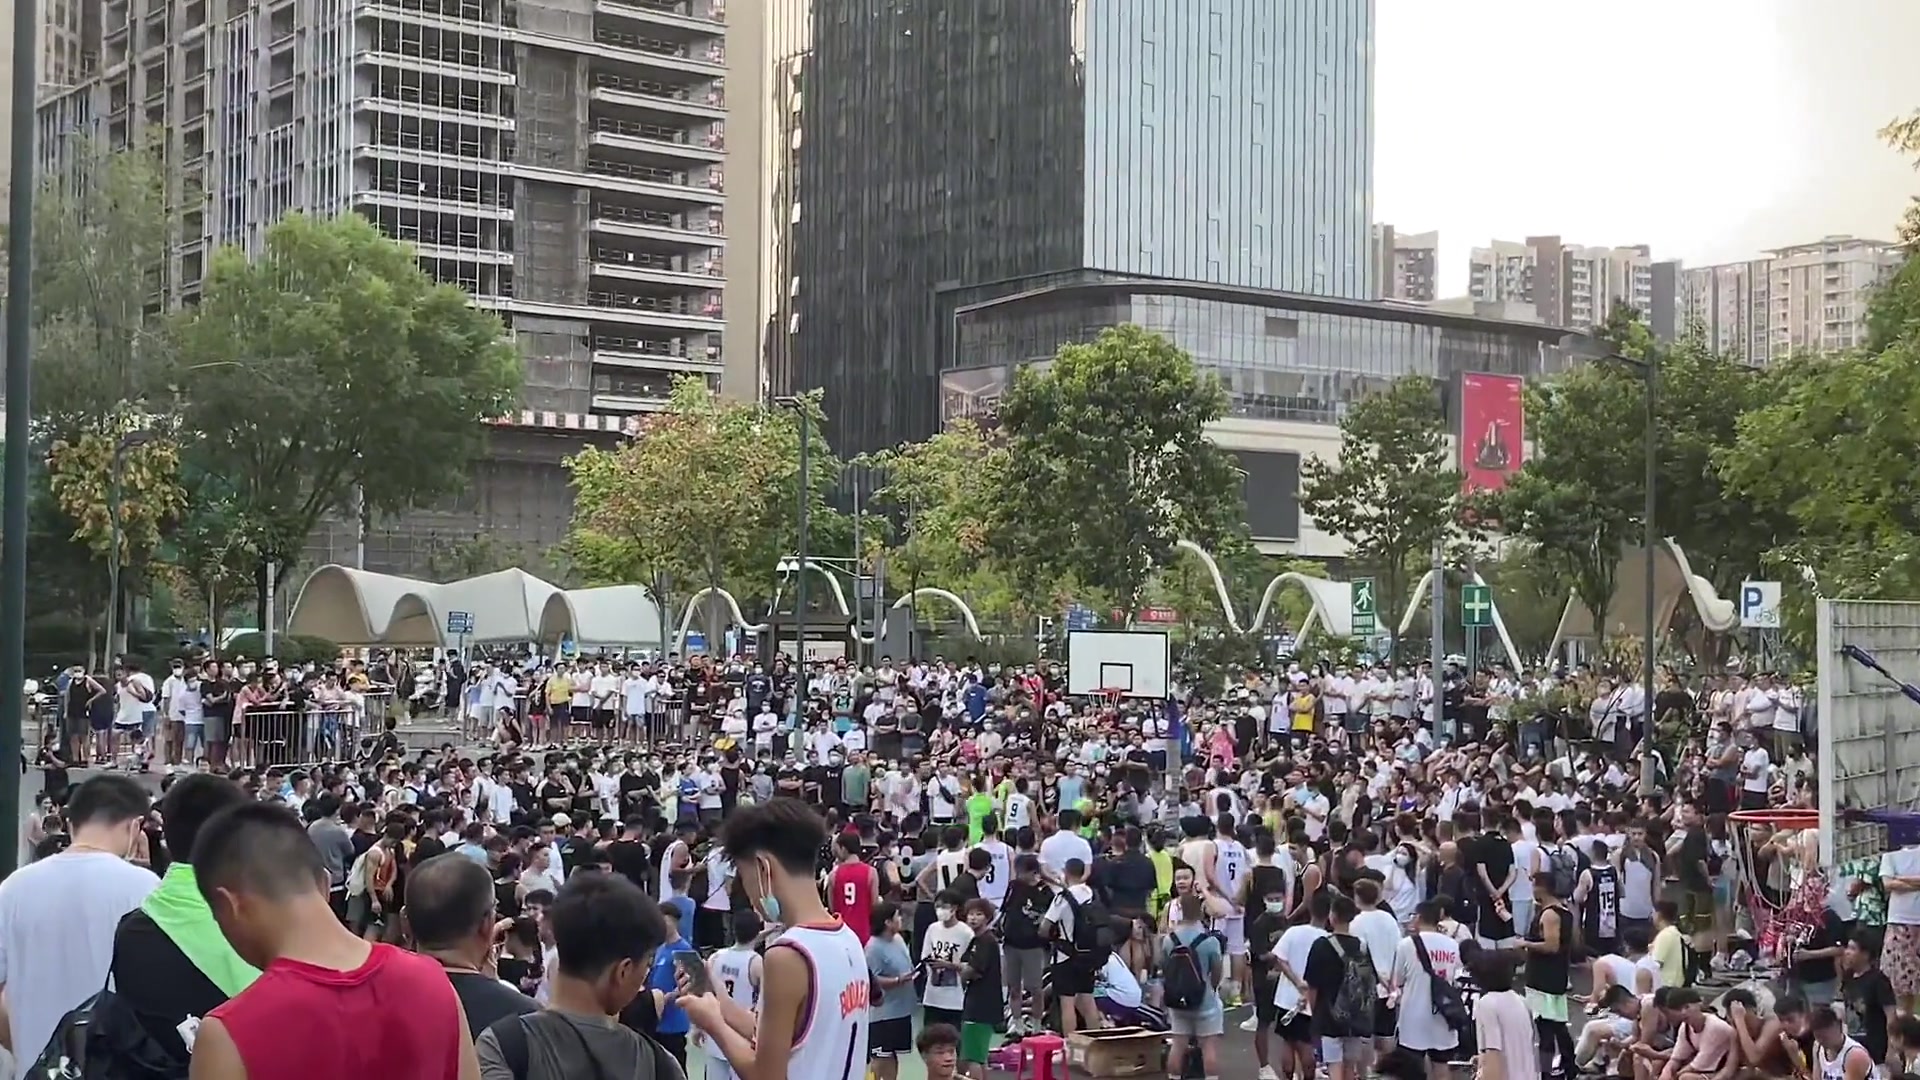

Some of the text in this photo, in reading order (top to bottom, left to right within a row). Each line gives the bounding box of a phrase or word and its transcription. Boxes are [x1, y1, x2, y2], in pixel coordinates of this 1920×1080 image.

[1744, 587, 1762, 618] P
[1010, 803, 1018, 817] 9
[844, 882, 856, 905] 9
[1601, 891, 1614, 910] 15
